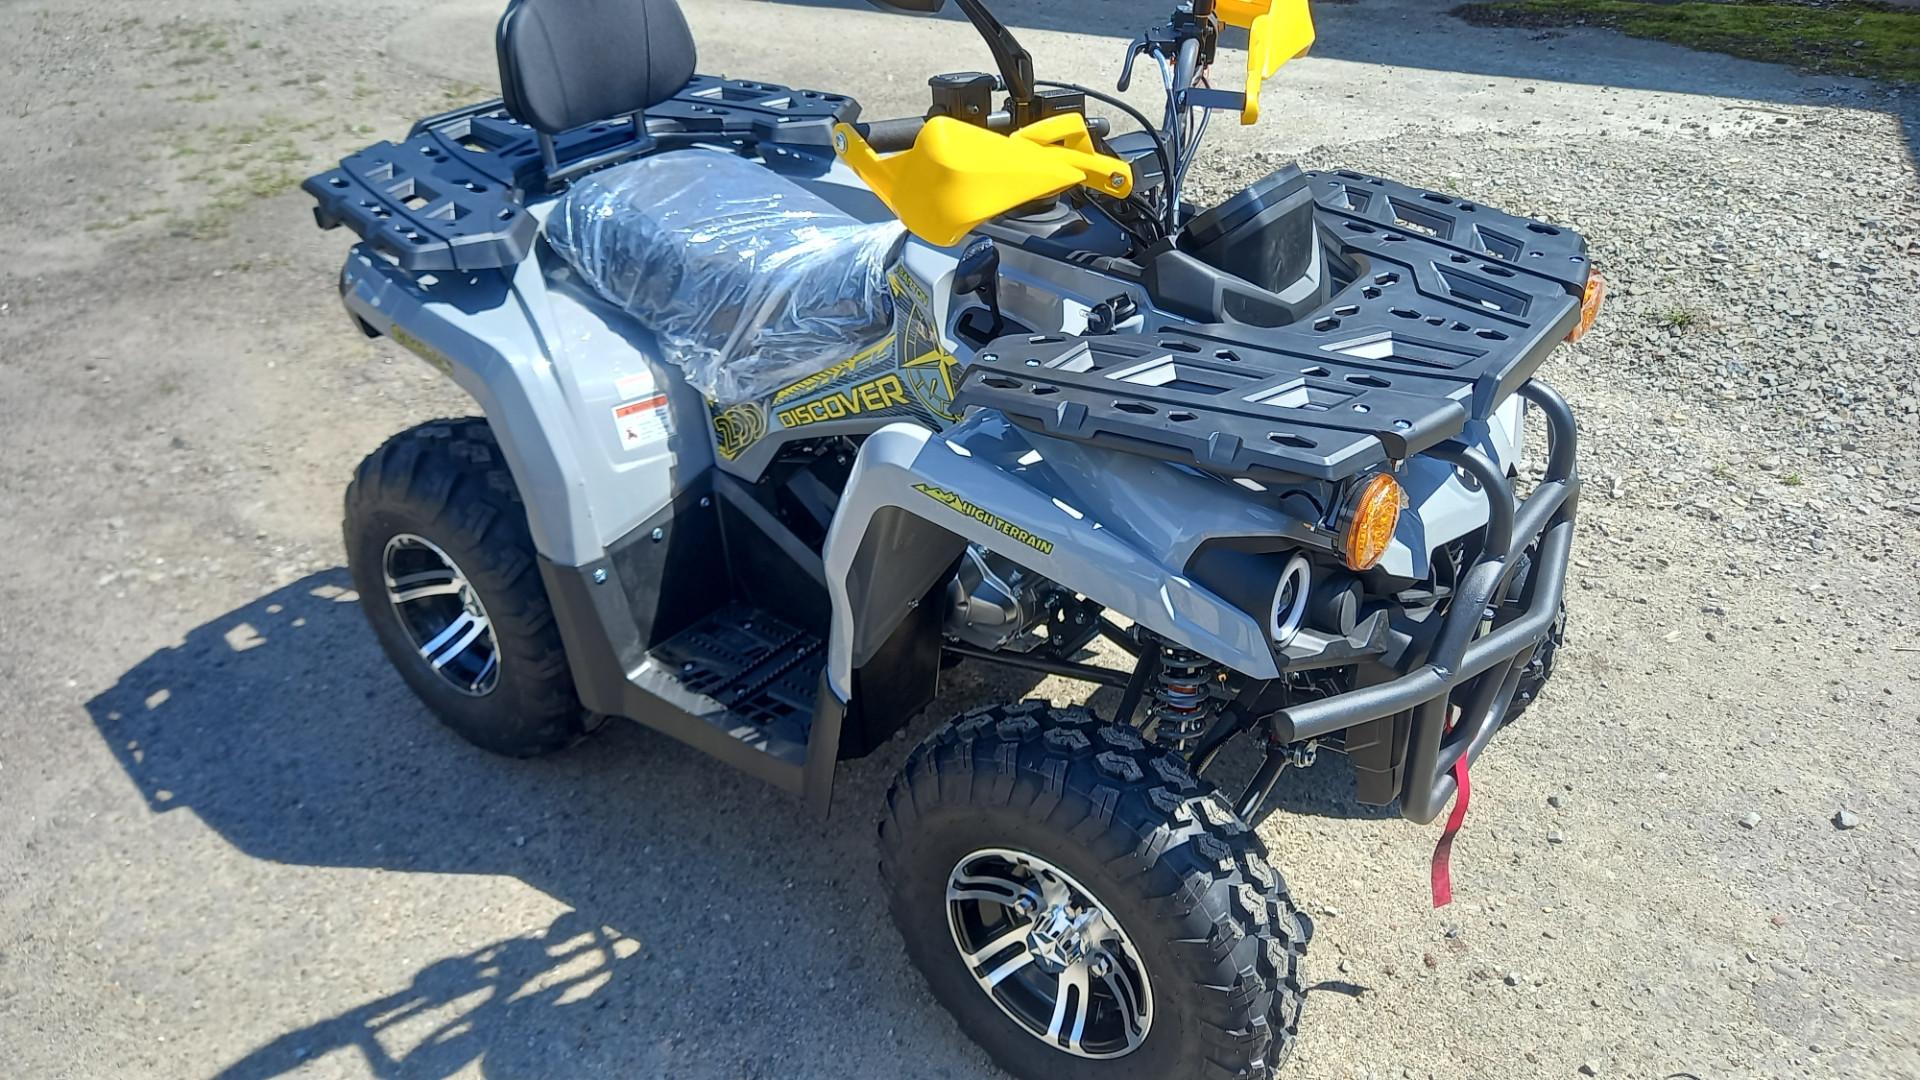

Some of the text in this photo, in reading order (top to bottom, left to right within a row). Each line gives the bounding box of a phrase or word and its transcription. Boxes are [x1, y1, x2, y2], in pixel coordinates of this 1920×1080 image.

[778, 374, 910, 428] DISCOVER
[963, 502, 1053, 554] HIGH TERRAIN
